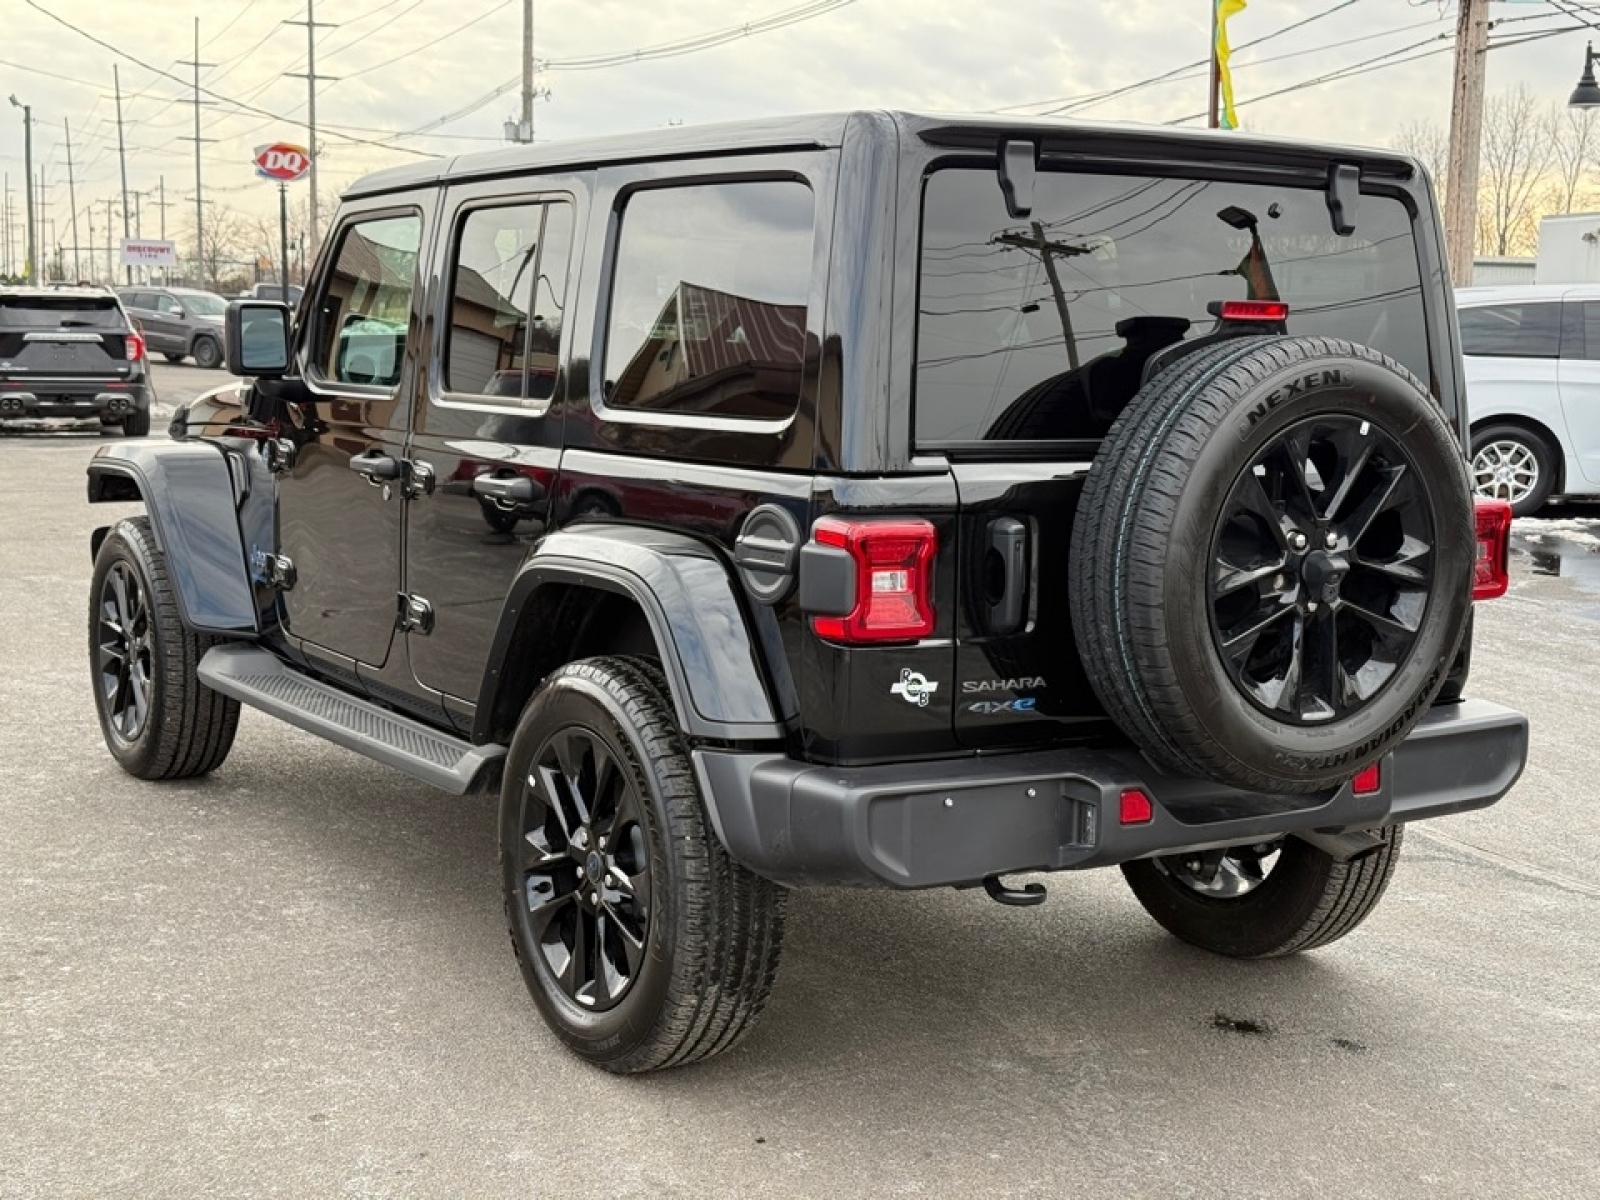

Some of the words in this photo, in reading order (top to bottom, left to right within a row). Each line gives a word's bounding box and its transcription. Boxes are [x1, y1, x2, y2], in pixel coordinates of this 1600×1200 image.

[266, 151, 302, 172] DQ
[1247, 369, 1340, 425] NEXEN
[962, 676, 1047, 693] SAHARA
[1355, 667, 1440, 759] ROADIAN
